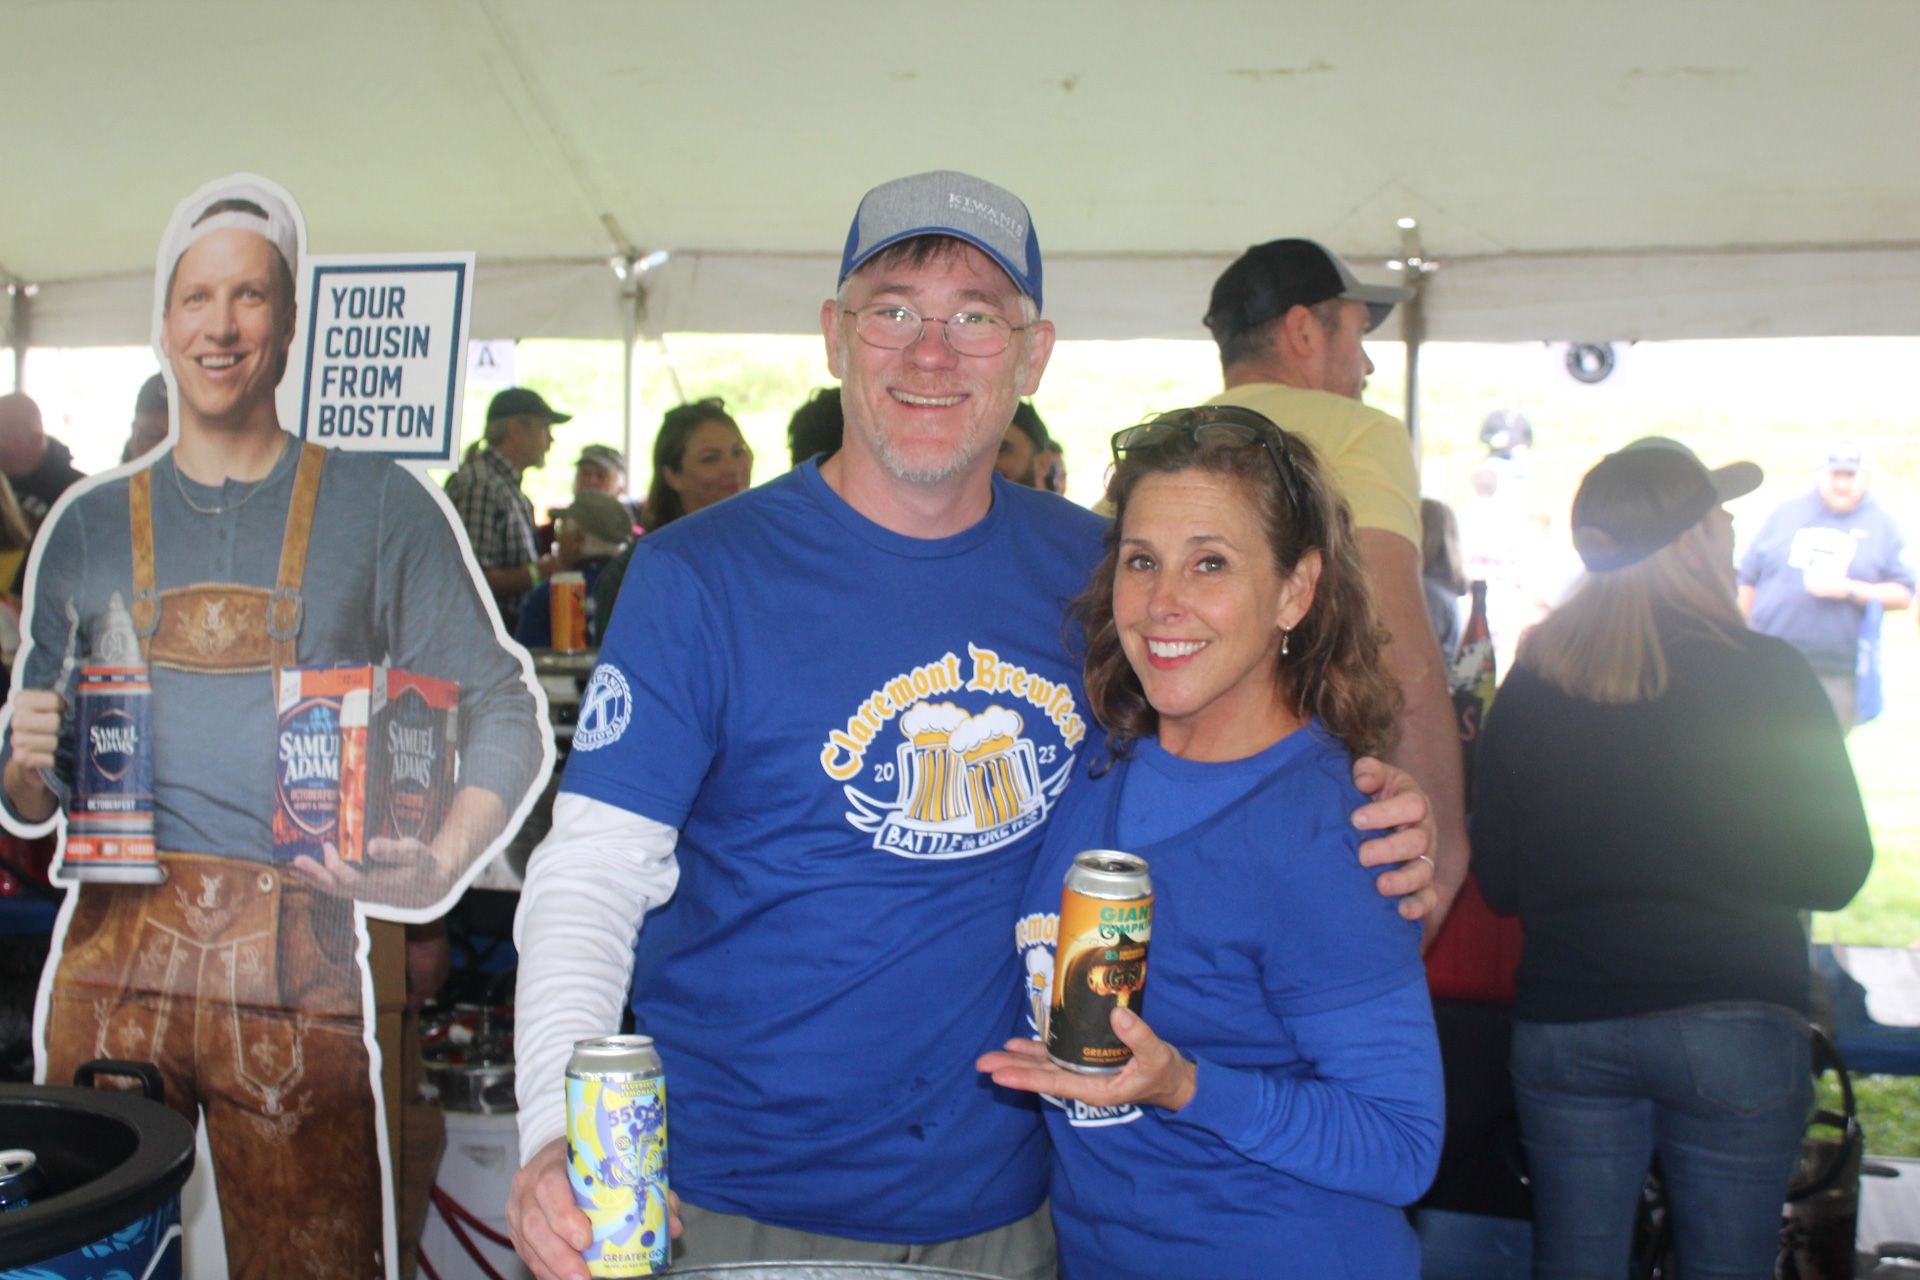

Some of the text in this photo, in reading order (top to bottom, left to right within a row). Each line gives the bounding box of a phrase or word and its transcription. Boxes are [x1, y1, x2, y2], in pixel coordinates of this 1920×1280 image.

[949, 193, 1023, 238] KIWANIS
[331, 286, 406, 319] YOUR
[324, 325, 431, 359] COUSIN
[320, 365, 403, 398] FROM
[317, 404, 435, 438] BOSTON
[820, 641, 1087, 781] Claremont Brewfest
[90, 725, 138, 743] SAMUEL
[93, 738, 134, 756] ADAMS
[279, 731, 340, 761] SAMU
[389, 720, 435, 760] SAMUEL
[1038, 745, 1056, 765] 23
[283, 756, 339, 786] ADAM
[390, 753, 431, 789] ADAMS
[874, 762, 895, 782] 20
[886, 825, 963, 854] BATTLE
[603, 1252, 647, 1262] GREATER
